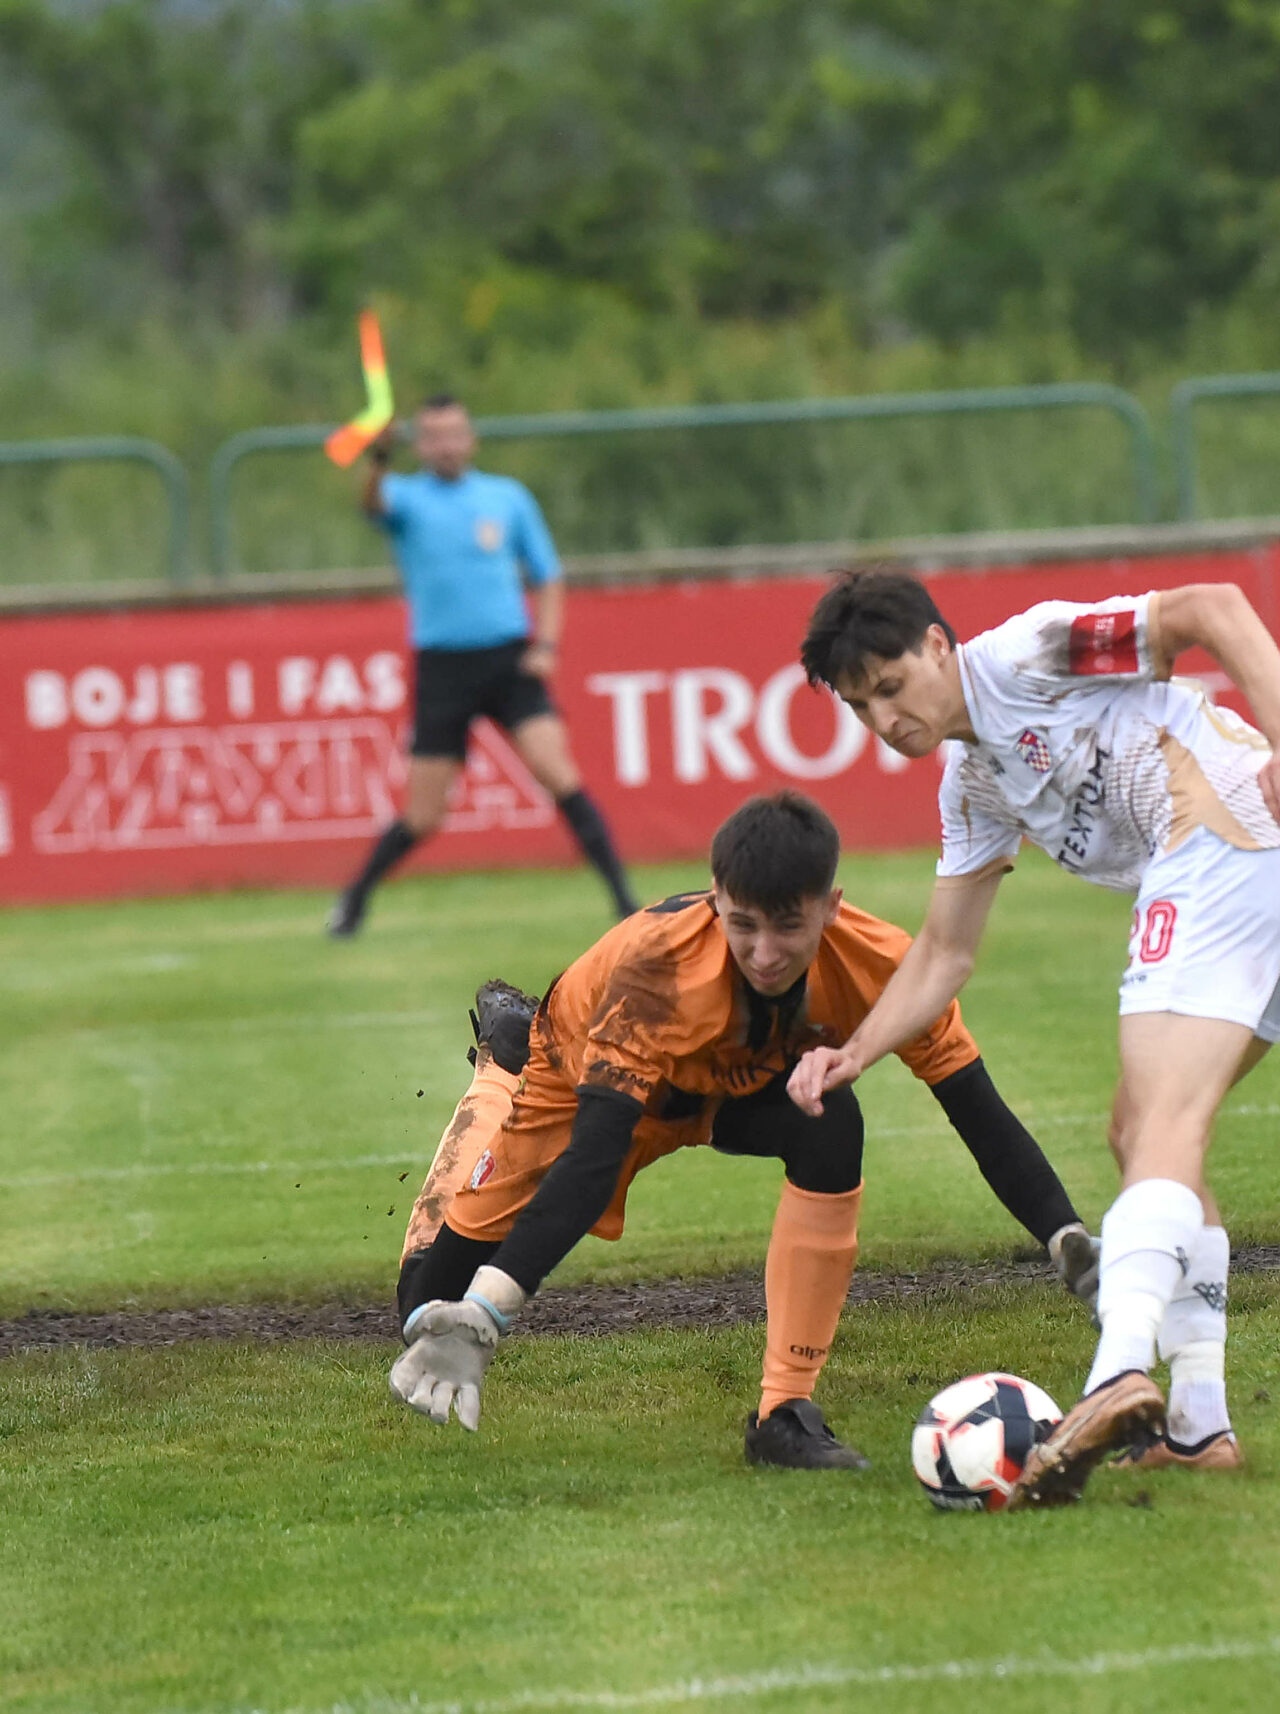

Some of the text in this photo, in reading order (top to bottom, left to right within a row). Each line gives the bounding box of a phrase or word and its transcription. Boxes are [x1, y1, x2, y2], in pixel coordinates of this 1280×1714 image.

[25, 651, 404, 730] BOJE I FAS
[585, 660, 912, 788] TRO
